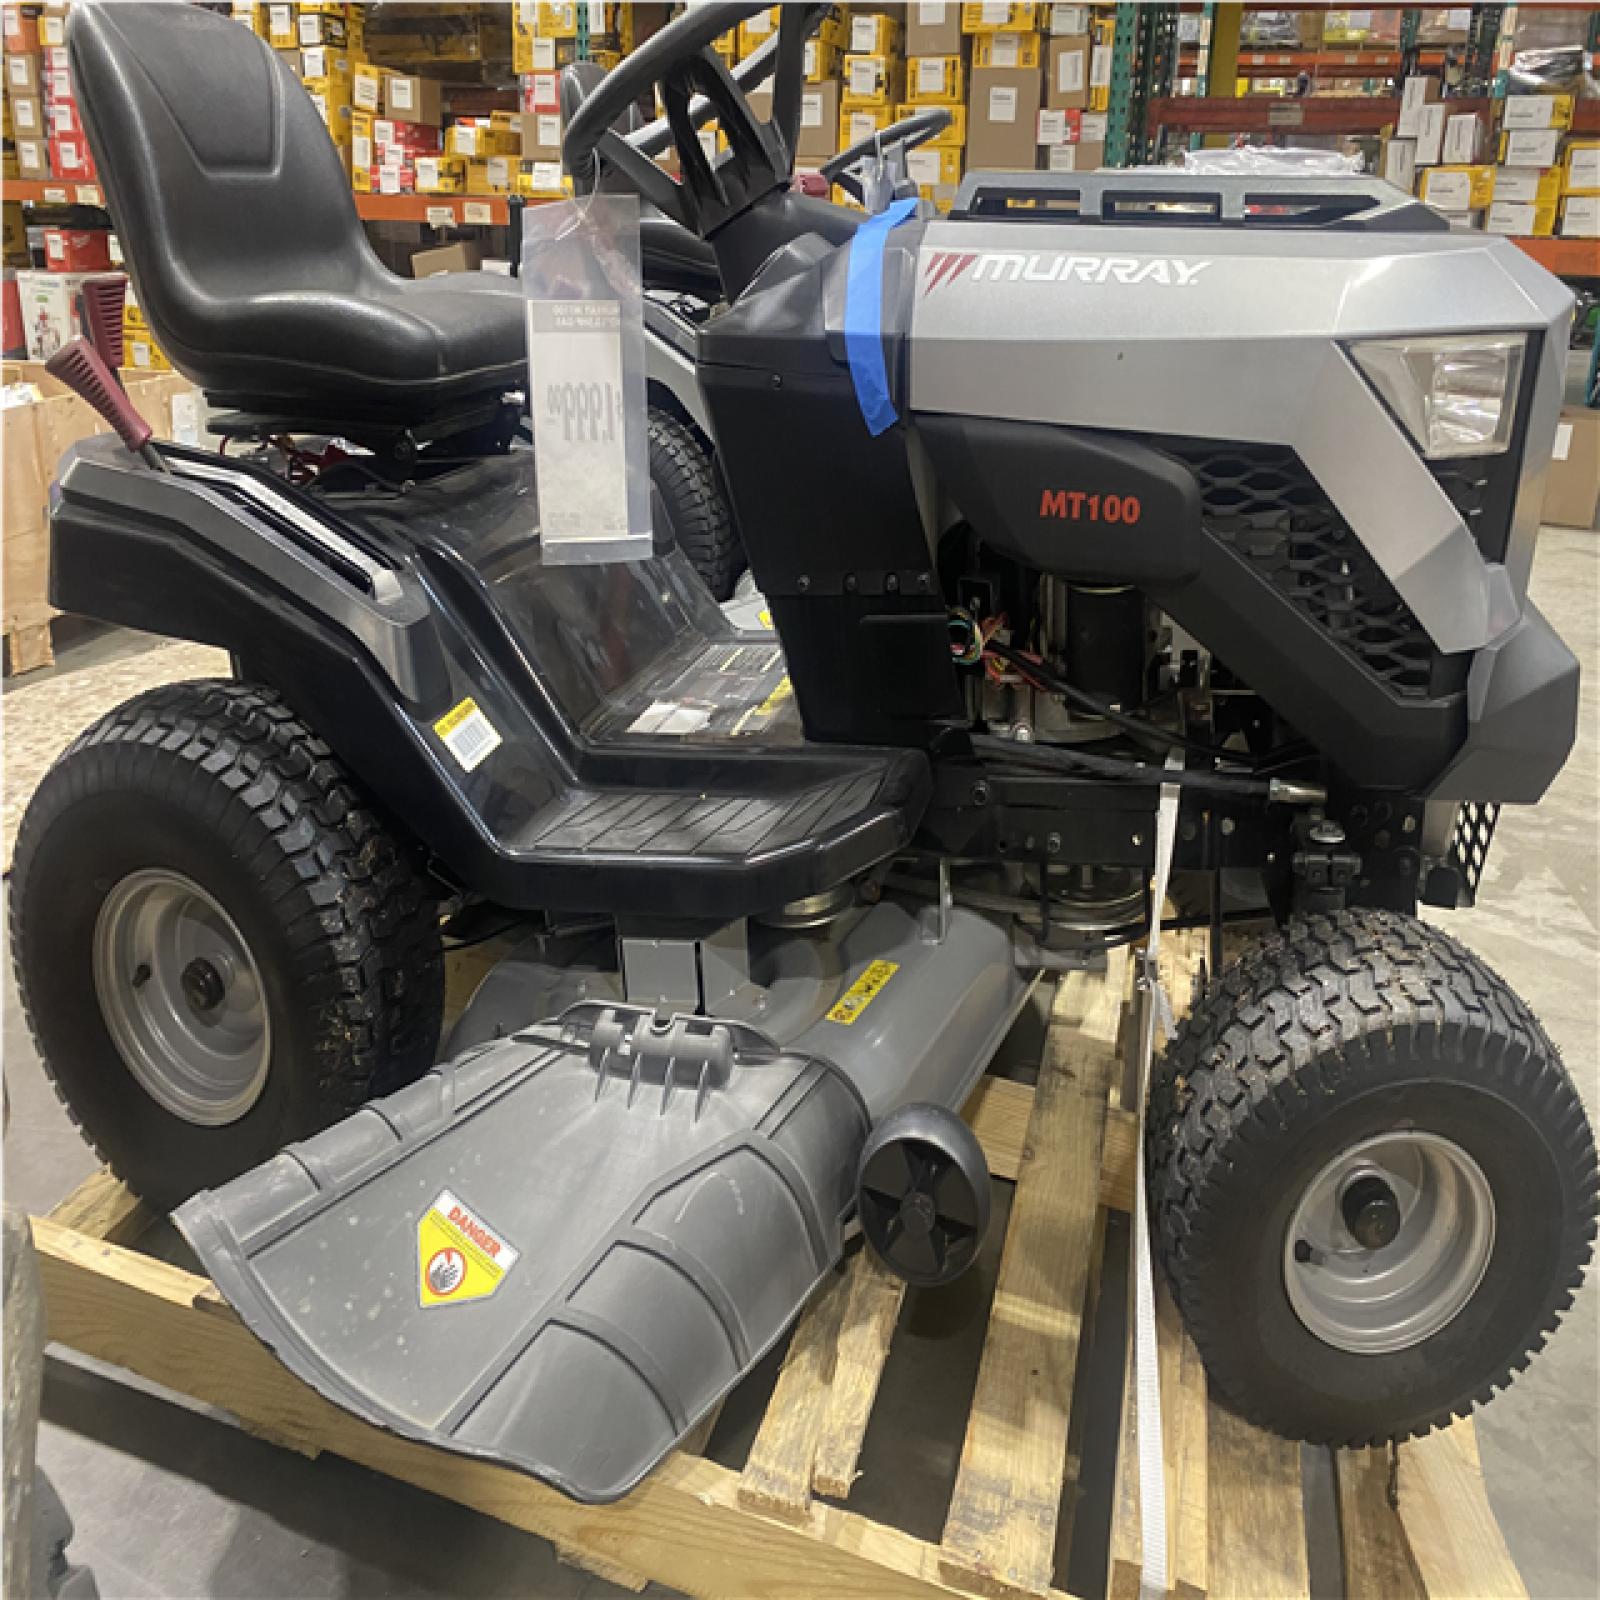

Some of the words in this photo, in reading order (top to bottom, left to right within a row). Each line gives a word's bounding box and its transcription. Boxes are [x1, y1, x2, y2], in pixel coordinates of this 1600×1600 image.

[971, 254, 1212, 285] MURRAY
[1040, 489, 1140, 524] MT100
[448, 1206, 501, 1258] DANGER
